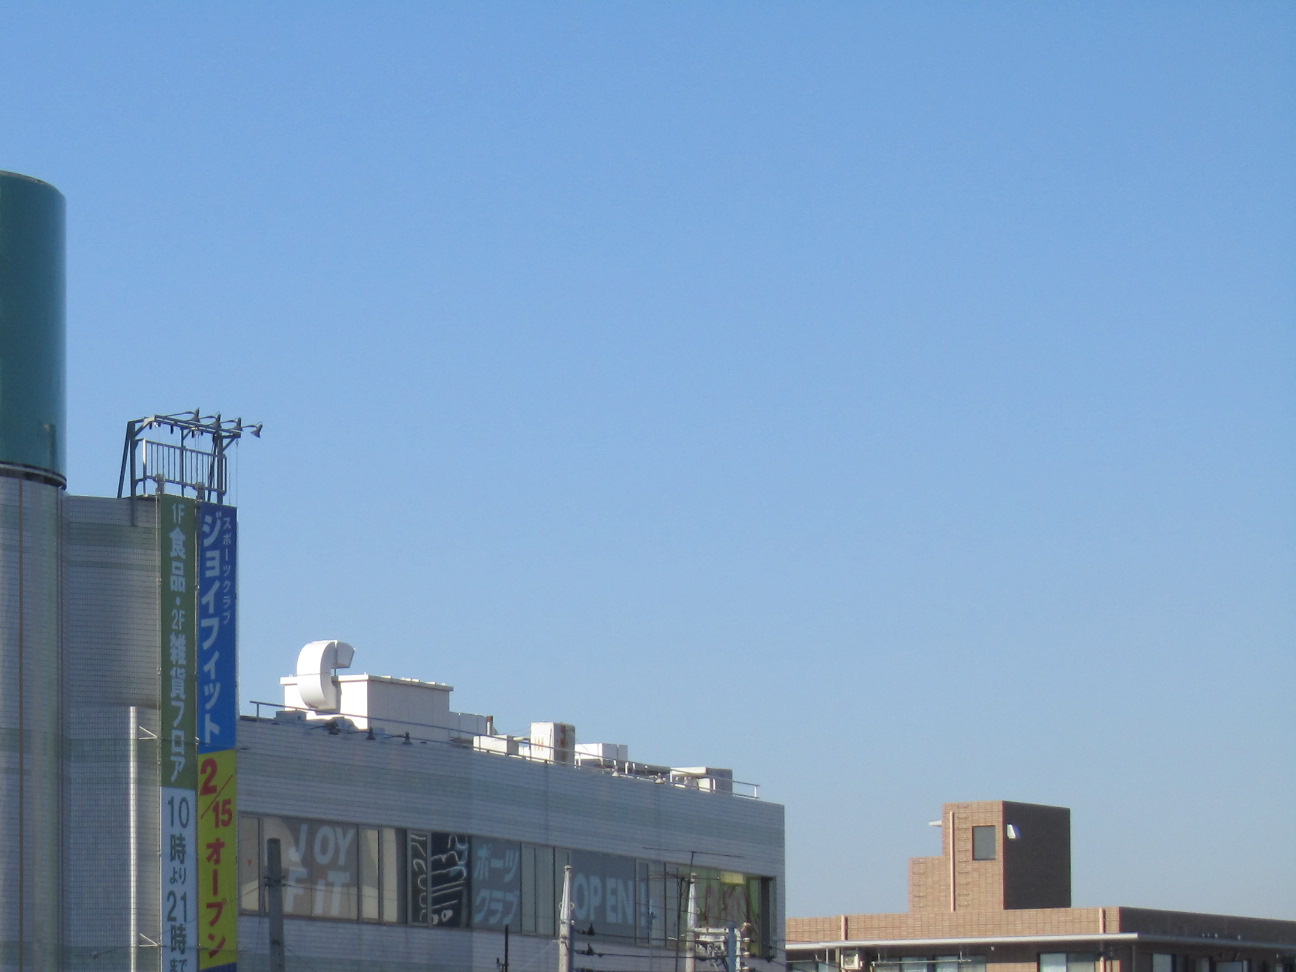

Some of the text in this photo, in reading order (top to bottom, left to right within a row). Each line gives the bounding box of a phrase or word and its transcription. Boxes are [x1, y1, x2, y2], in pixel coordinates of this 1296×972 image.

[222, 517, 232, 624] スポーツクラブ
[200, 511, 222, 744] ジョイフィット
[206, 838, 227, 958] オープン
[288, 824, 356, 866] JOY
